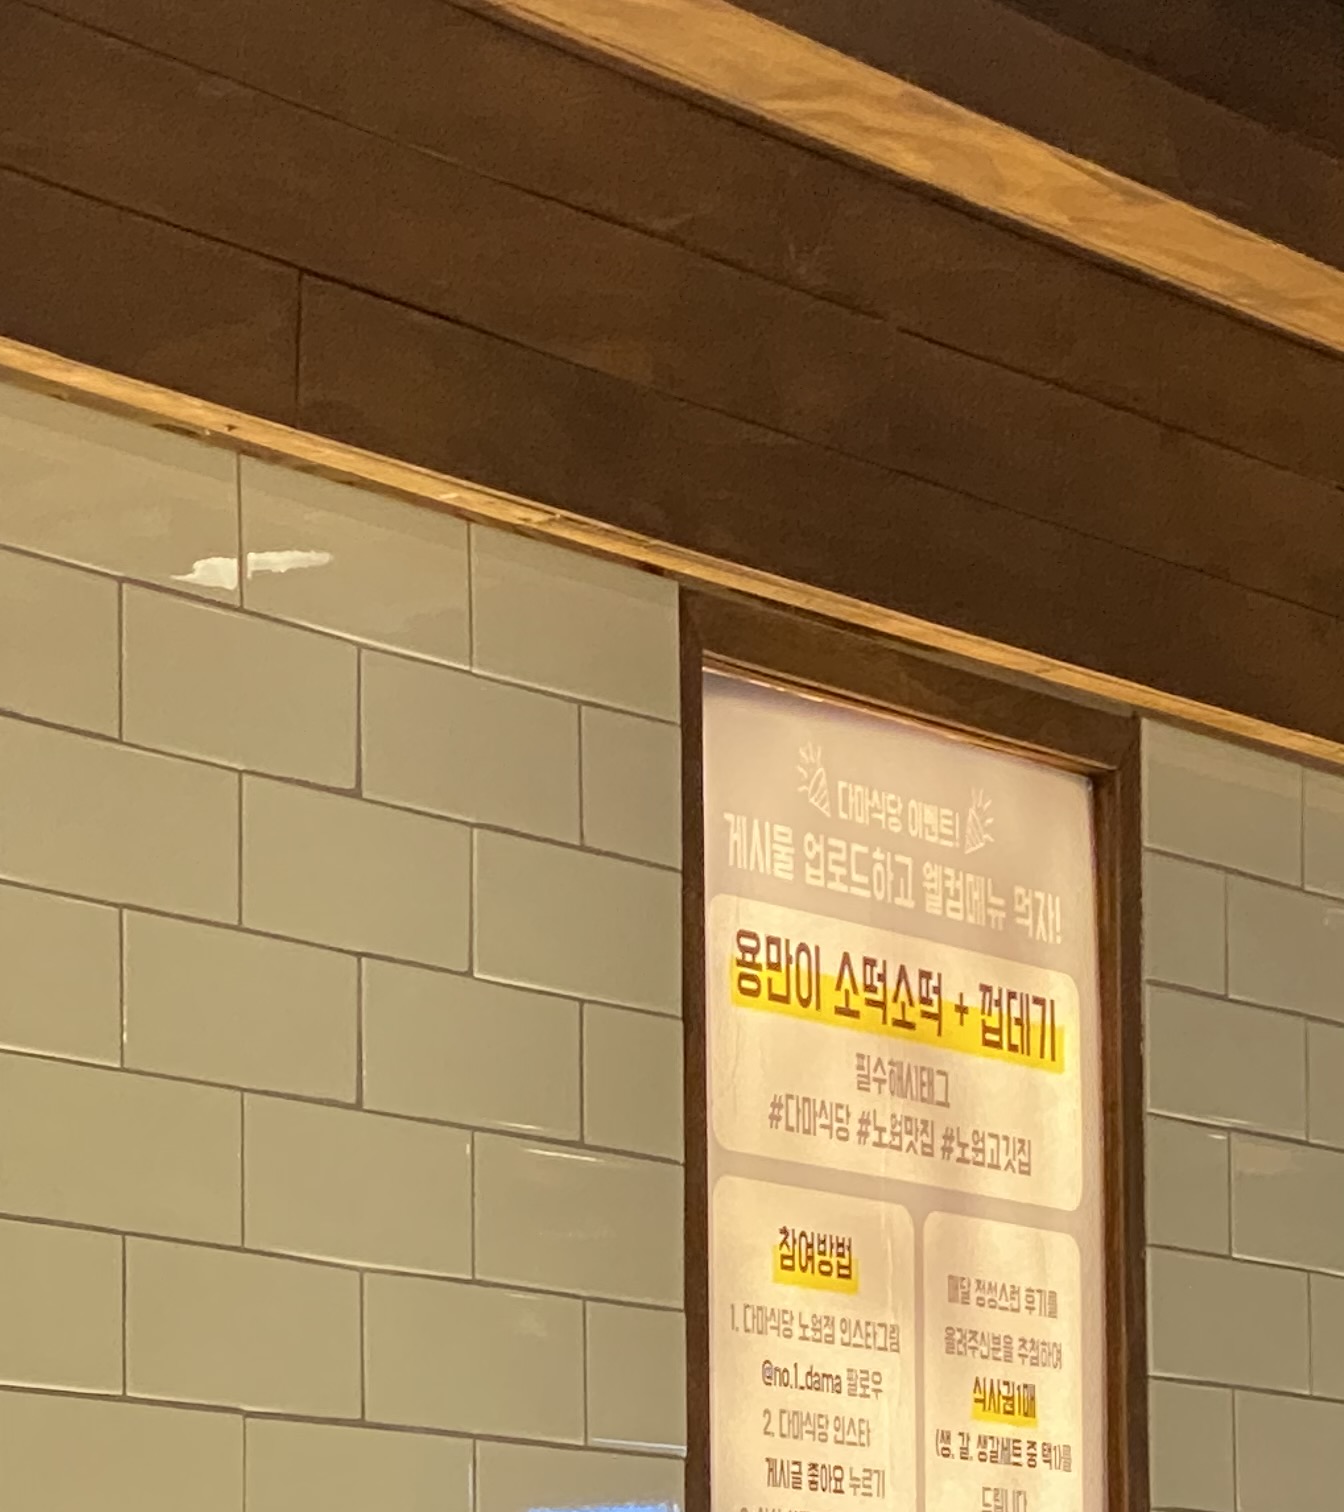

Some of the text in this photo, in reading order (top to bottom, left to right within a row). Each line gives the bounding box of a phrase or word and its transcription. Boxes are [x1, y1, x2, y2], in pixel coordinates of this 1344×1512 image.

[837, 781, 960, 848] 다마식당 이벤트!
[723, 812, 1062, 944] 게시물 업로드하고 웰컴메뉴 먹자!
[736, 929, 821, 1012] 용만이
[834, 951, 943, 1037] 소떡소떡
[979, 983, 1056, 1062] 껍데기
[856, 1052, 950, 1109] 필수해시태그
[768, 1093, 1032, 1177] #다마식당 #노원맛집 #노원고깃집
[778, 1225, 852, 1280] 참여방법
[743, 1303, 794, 1340] 다마식당
[798, 1311, 836, 1345] 노원점
[846, 1368, 884, 1400] 팔로우
[779, 1408, 829, 1443] 다마식당
[833, 1415, 871, 1447] 인스타
[765, 1457, 886, 1499] 게시글 좋아요 누르기
